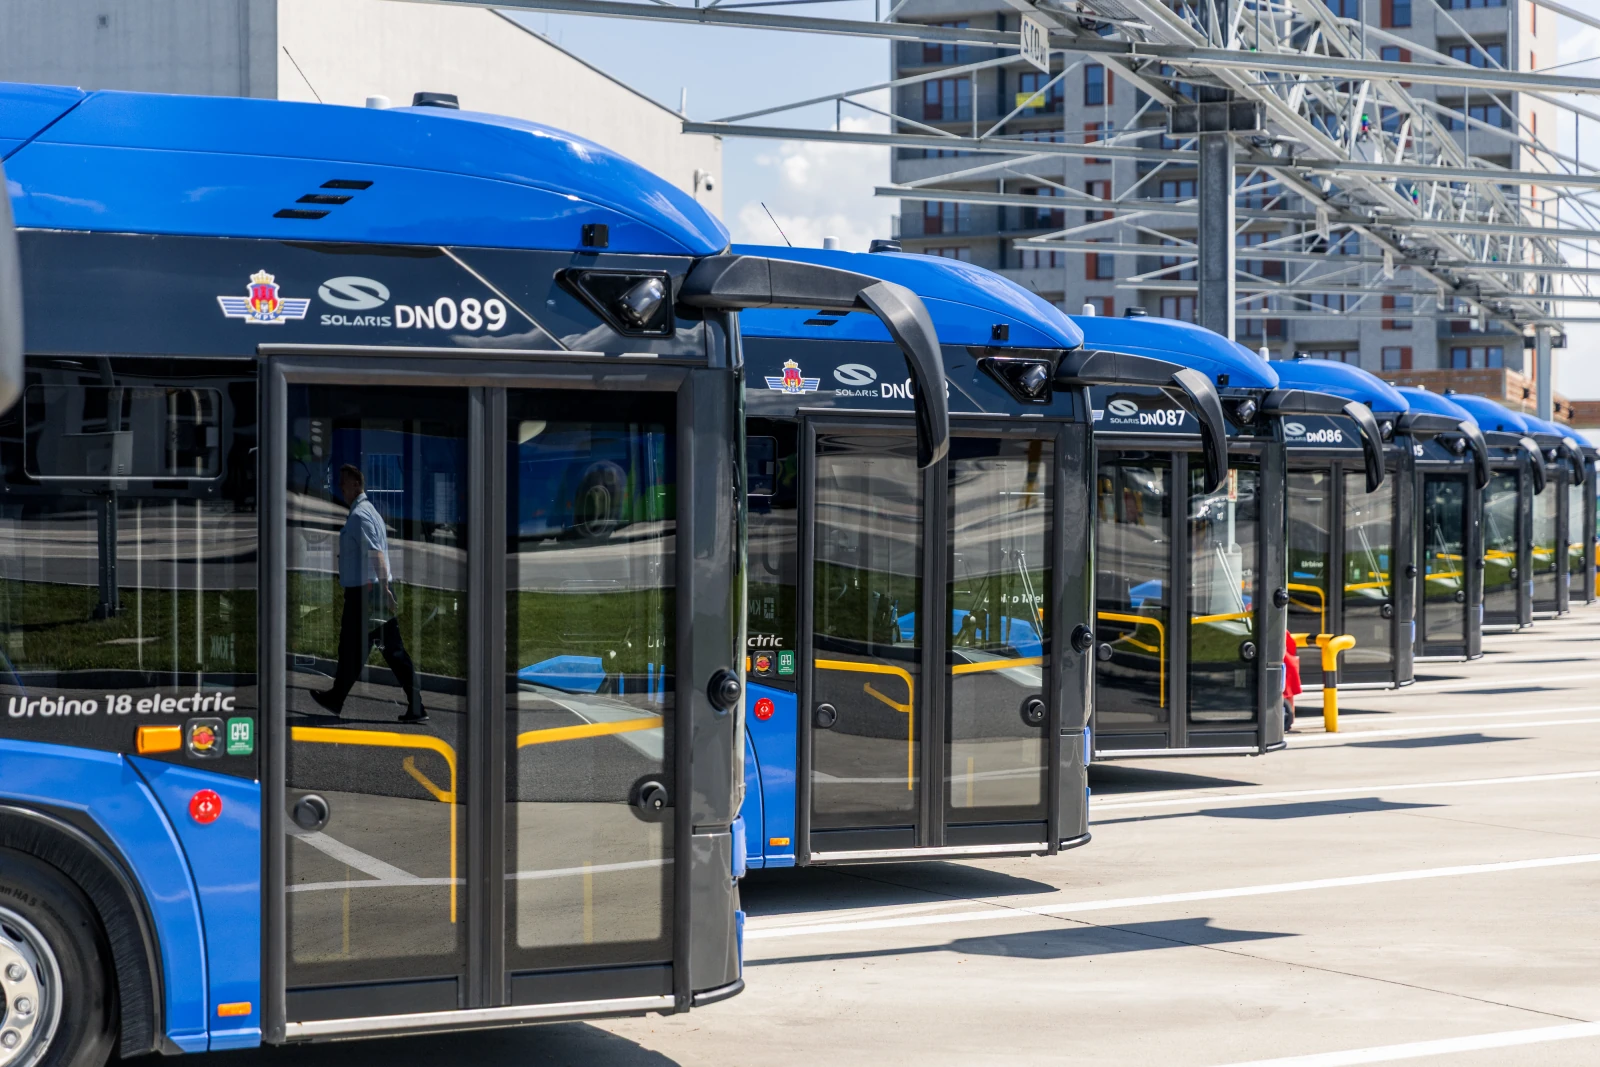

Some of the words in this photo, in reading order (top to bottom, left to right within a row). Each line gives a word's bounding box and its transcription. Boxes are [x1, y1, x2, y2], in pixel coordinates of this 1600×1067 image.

[320, 313, 392, 328] SOLARIS
[394, 296, 508, 331] DN089
[835, 388, 879, 398] SOLARIS
[1109, 417, 1140, 425] SOLARIS
[1138, 408, 1186, 427] DN087
[1306, 428, 1343, 443] DN086
[8, 695, 98, 718] Urbino
[105, 693, 133, 716] 18
[136, 691, 237, 714] electric
